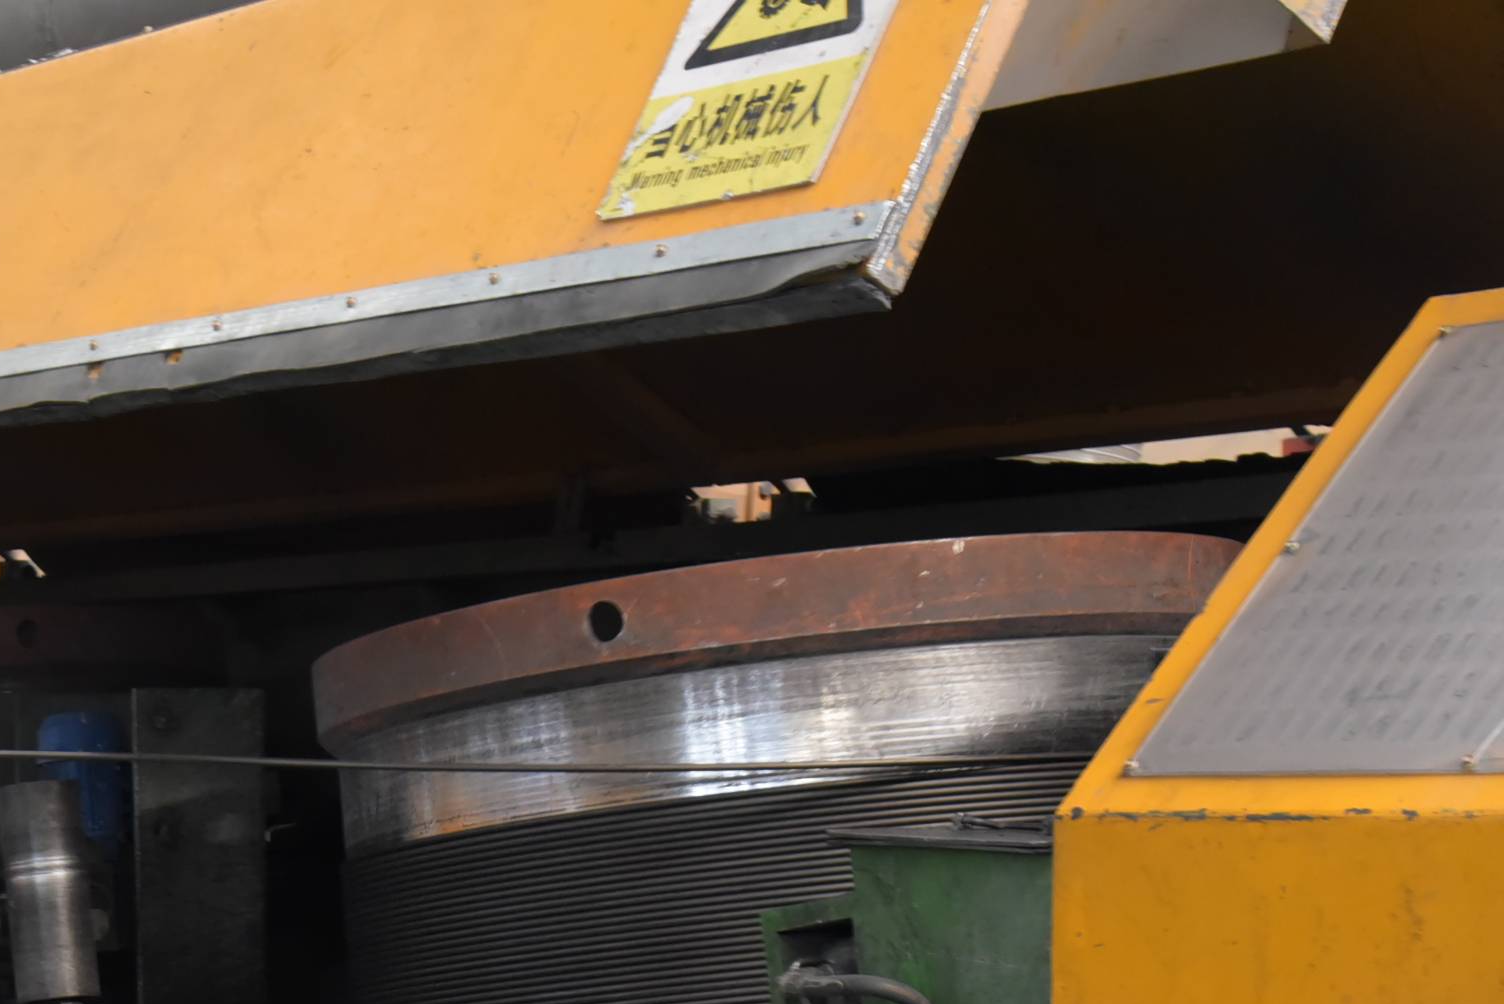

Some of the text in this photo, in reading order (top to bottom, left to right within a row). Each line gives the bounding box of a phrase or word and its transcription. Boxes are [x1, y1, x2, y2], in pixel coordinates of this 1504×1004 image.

[645, 75, 830, 159] 当心机械伤人
[627, 144, 811, 190] Warning mechanical injury
